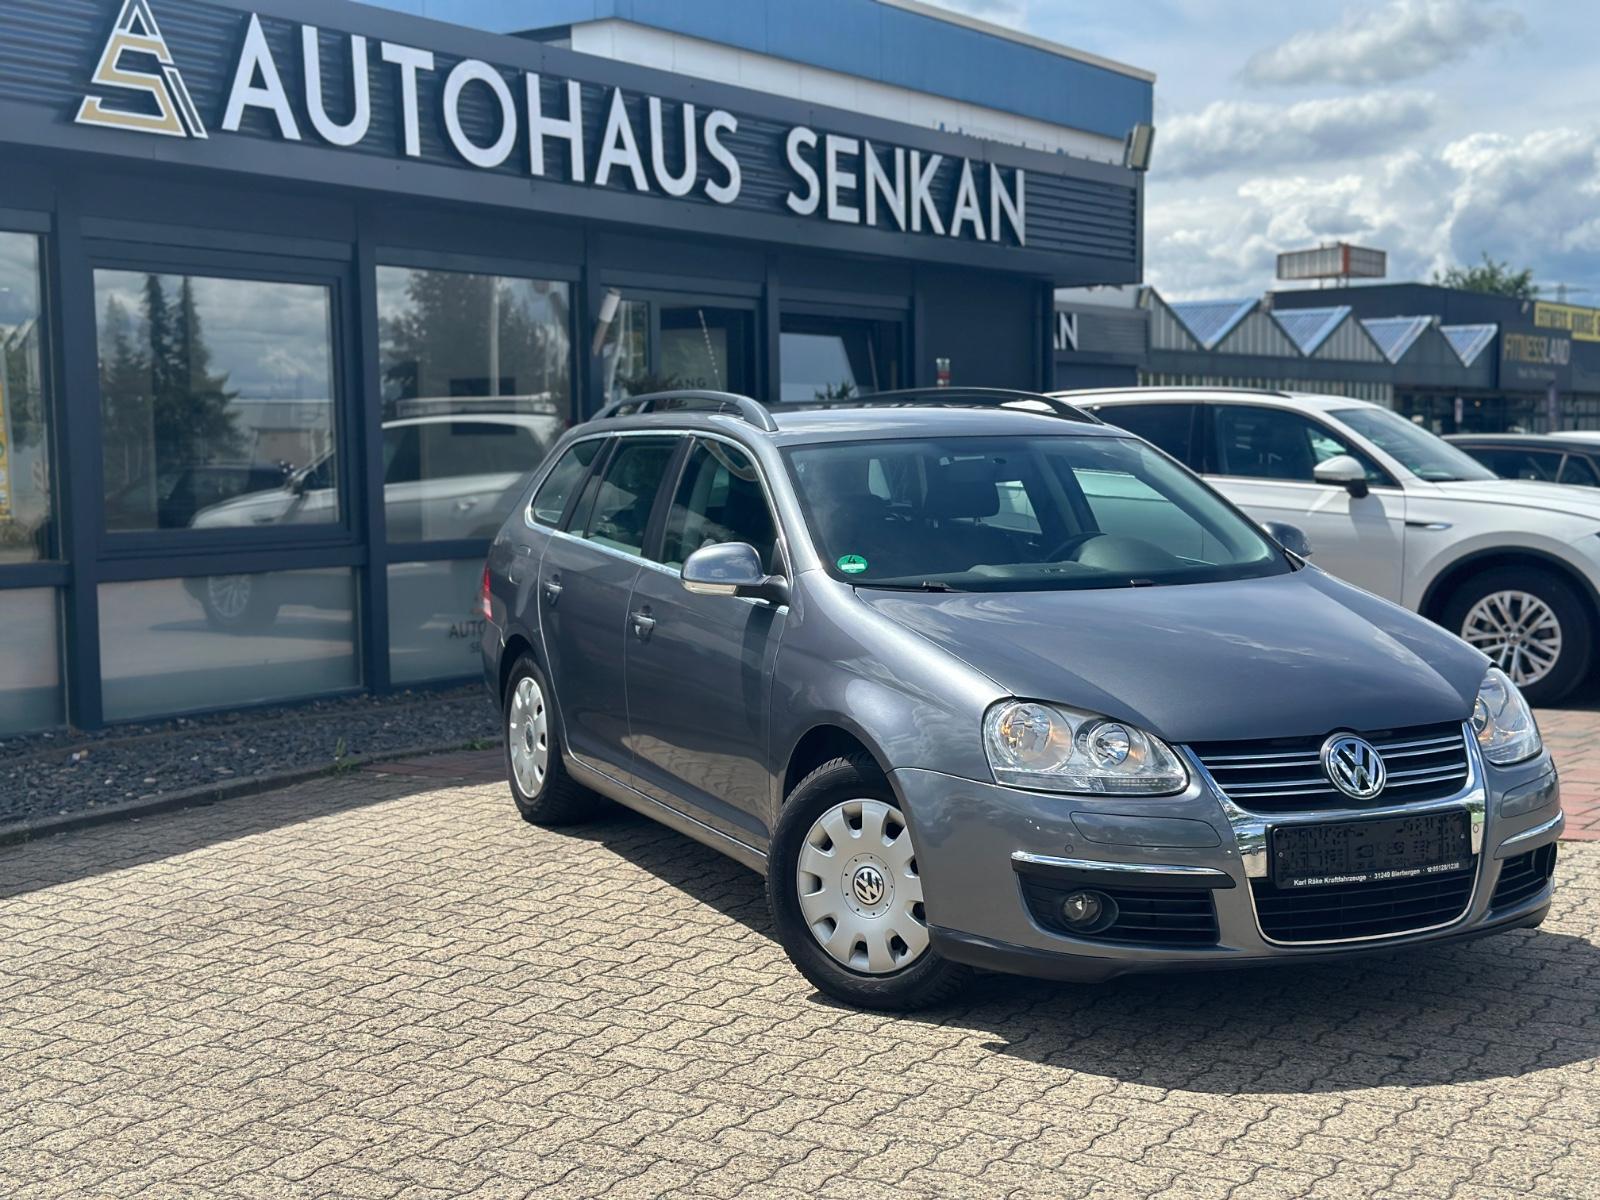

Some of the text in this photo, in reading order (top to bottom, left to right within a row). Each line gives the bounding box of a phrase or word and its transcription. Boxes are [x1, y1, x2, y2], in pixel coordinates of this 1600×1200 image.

[221, 12, 1026, 246] AUTOHAUS SENKAN
[1053, 311, 1078, 351] N
[847, 555, 857, 564] 4
[1324, 874, 1367, 884] Kraftfahrzeuge
